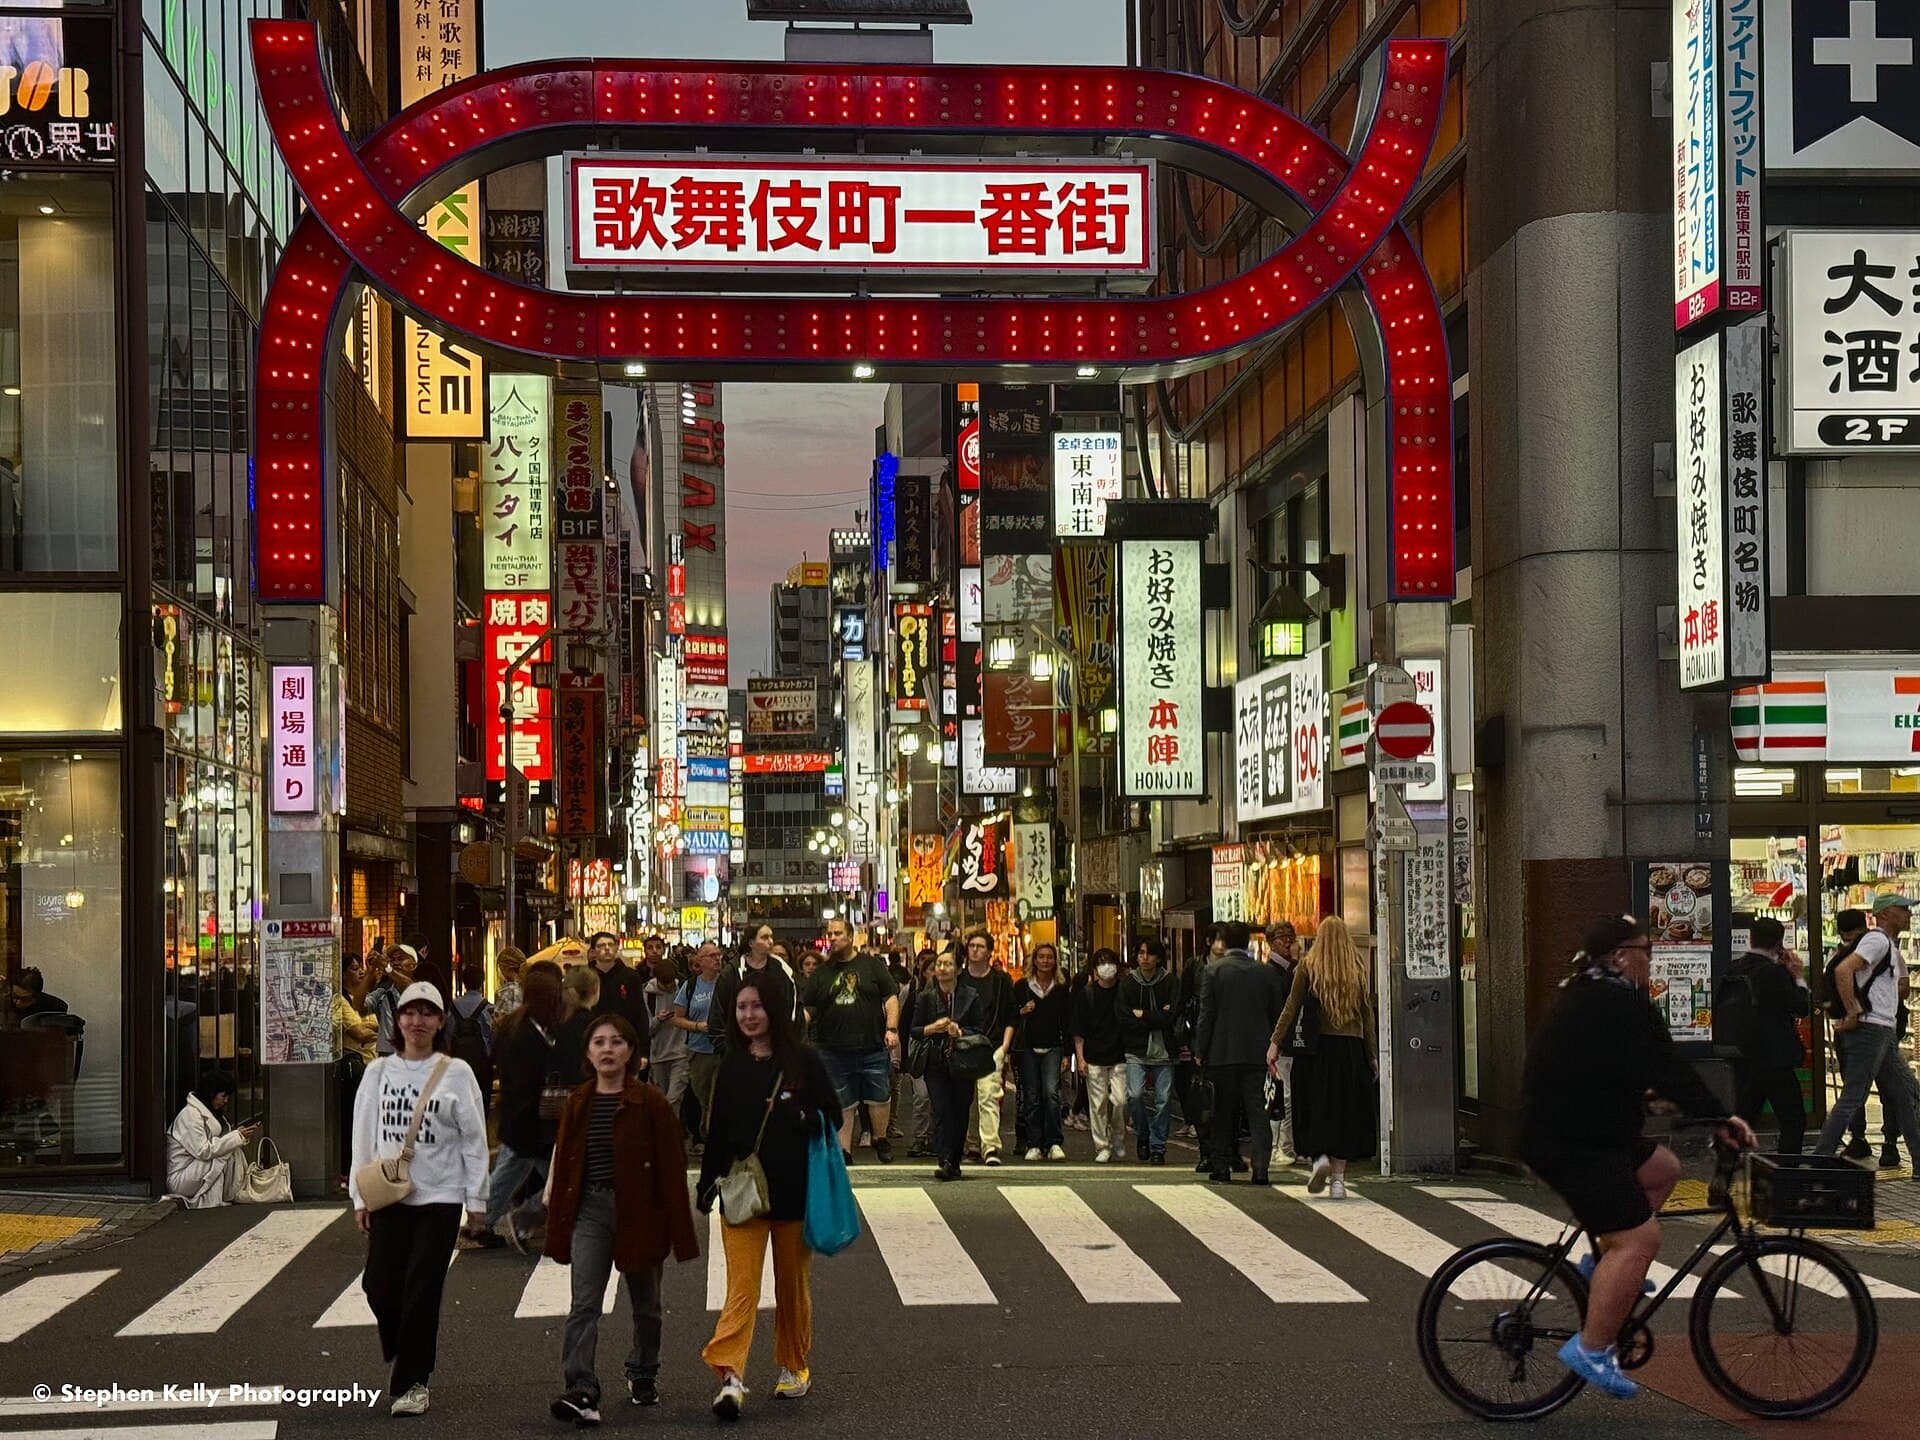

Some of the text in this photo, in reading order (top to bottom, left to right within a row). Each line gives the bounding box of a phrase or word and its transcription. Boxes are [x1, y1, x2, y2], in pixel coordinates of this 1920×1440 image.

[1687, 36, 1702, 284] ファイトフィット
[592, 176, 1130, 256] 歌舞伎町一番街
[1677, 141, 1687, 292] 新宿東口駅前
[1735, 190, 1751, 281] 新宿東口駅前
[1688, 294, 1706, 319] B2F
[1730, 290, 1758, 306] B2F
[1057, 437, 1118, 450] 全卓全自動
[1844, 418, 1910, 442] 2F
[490, 435, 522, 547] バンタイ
[529, 436, 542, 540] タイ国料理専門店
[1070, 454, 1093, 533] 東南荘
[1689, 364, 1708, 590] お好み焼き
[1732, 392, 1759, 612] 歌舞伎町名物
[562, 519, 598, 535] B1F
[490, 563, 542, 571] RESTAURANT
[504, 574, 529, 586] 3F
[489, 598, 548, 626] 焼肉
[1087, 550, 1110, 665] ハイボール
[1147, 548, 1176, 688] お好み焼き
[1683, 600, 1719, 650] 本陣
[570, 676, 593, 688] 4F
[1685, 651, 1717, 683] HONJIN
[281, 677, 306, 800] 劇場通り
[1086, 737, 1112, 752] 2F
[1148, 698, 1179, 766] 本陣
[1295, 722, 1318, 784] 190
[1379, 766, 1432, 780] 自転車を除く
[1135, 771, 1193, 791] HONJIN
[1698, 813, 1711, 825] 17
[684, 832, 729, 848] SAUNA
